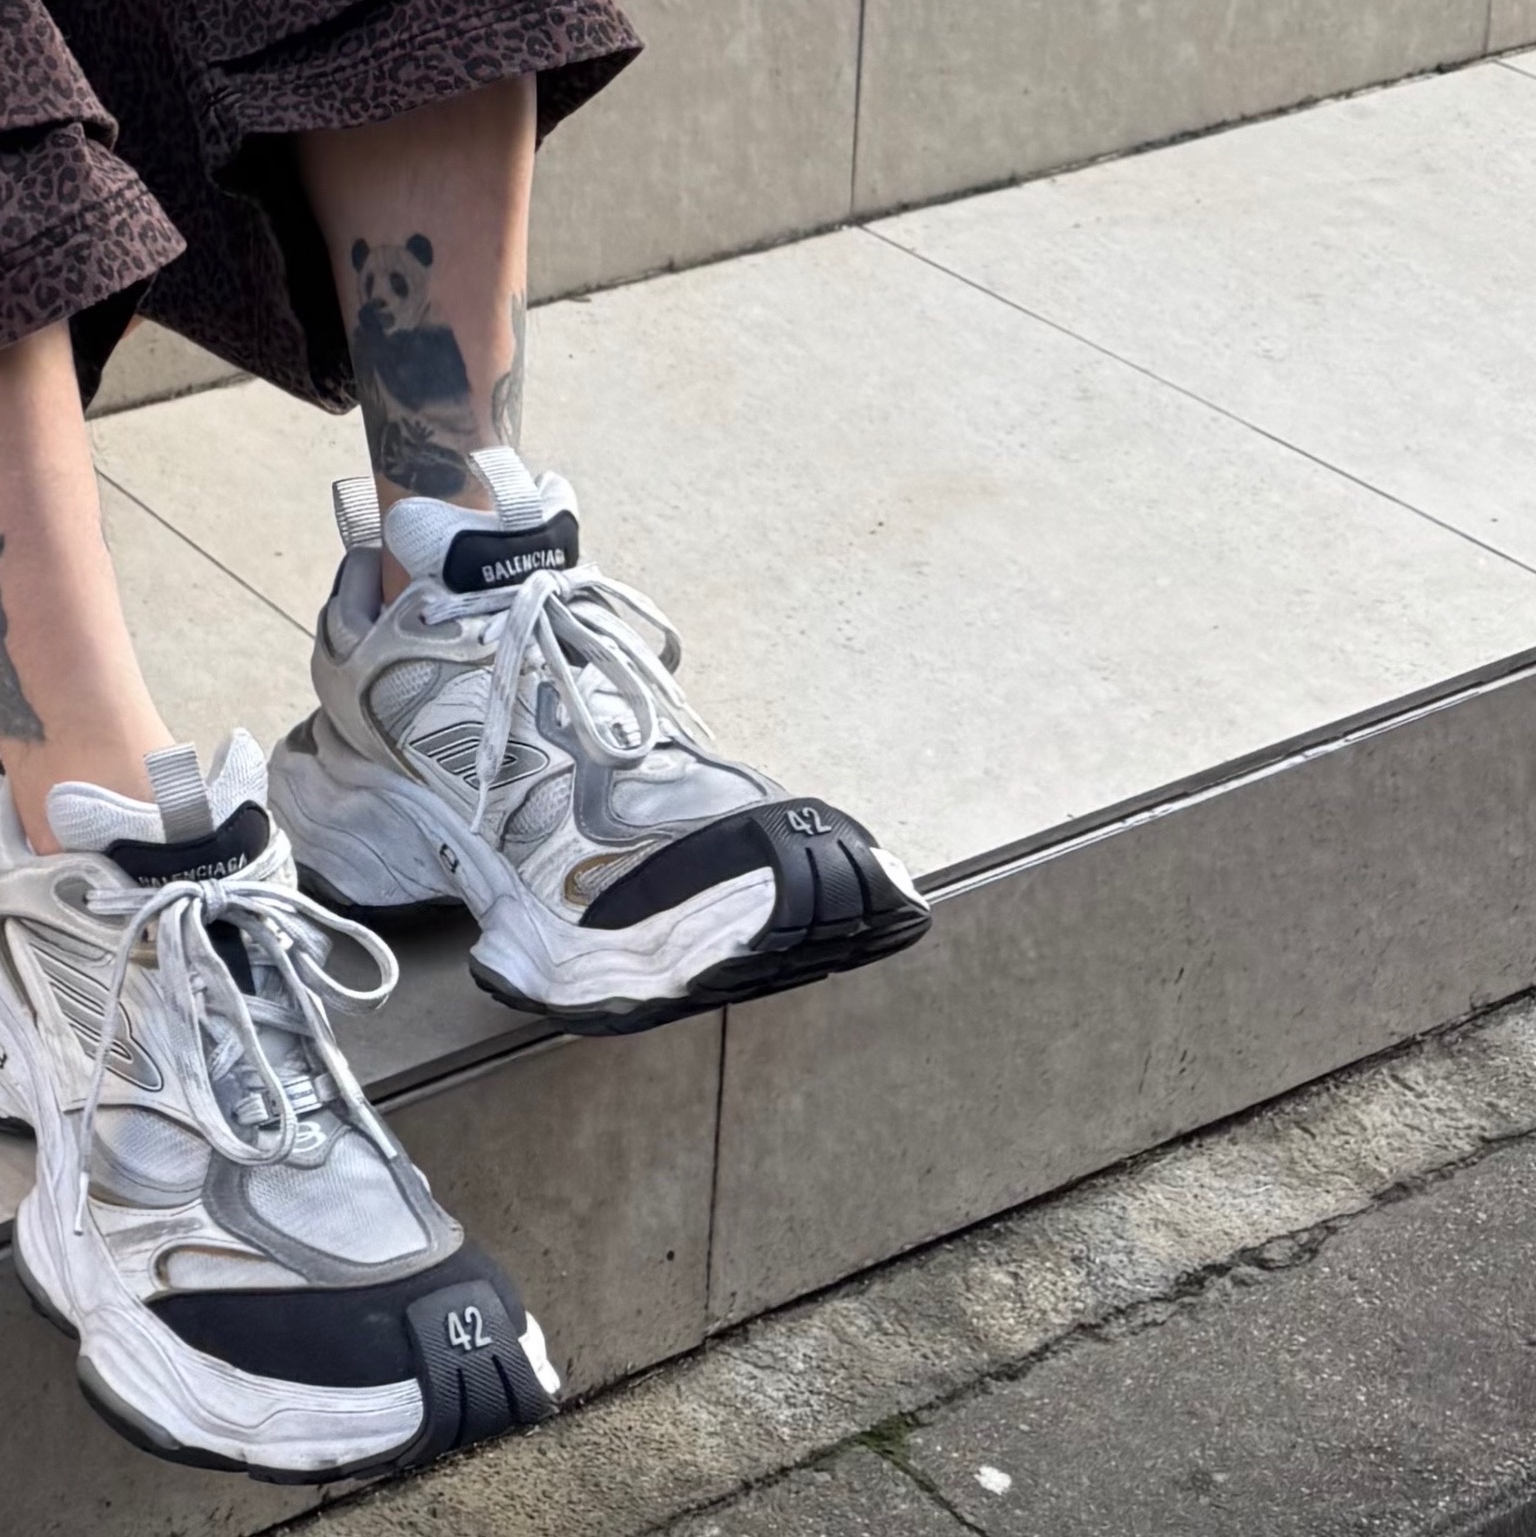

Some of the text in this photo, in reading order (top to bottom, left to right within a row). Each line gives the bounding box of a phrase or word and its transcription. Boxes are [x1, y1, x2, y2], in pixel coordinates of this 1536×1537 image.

[787, 807, 831, 835] 42
[138, 852, 248, 888] ANCIAGA
[447, 1306, 492, 1350] 42
